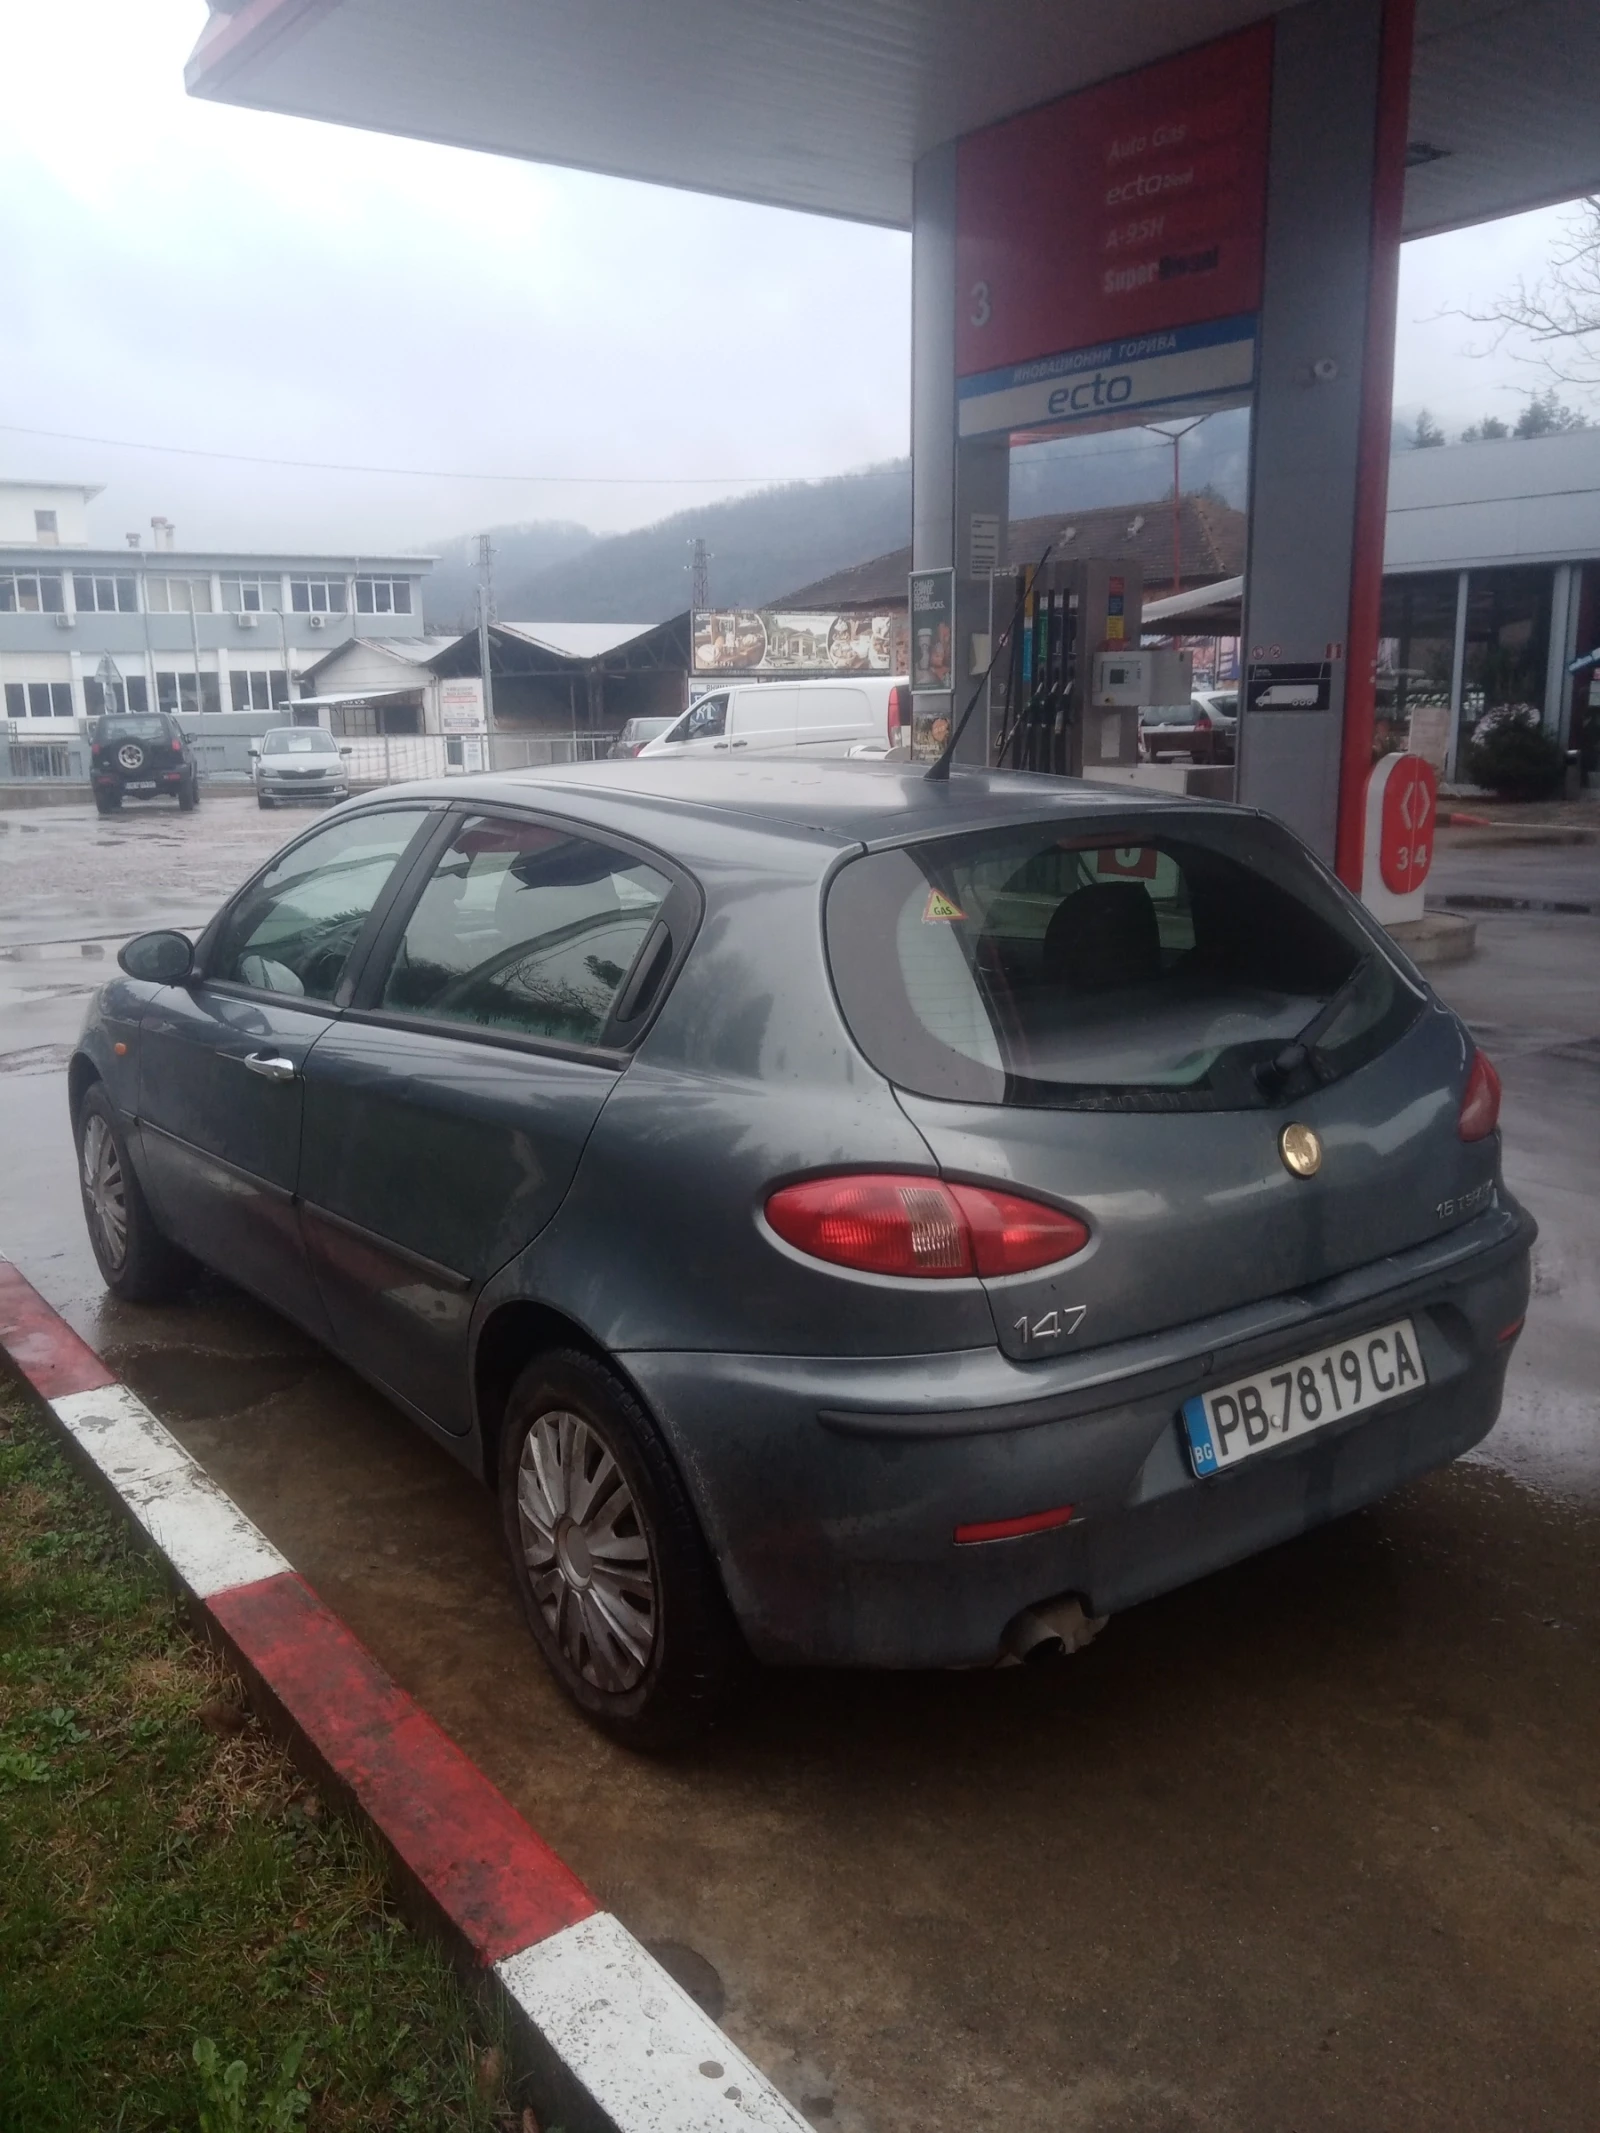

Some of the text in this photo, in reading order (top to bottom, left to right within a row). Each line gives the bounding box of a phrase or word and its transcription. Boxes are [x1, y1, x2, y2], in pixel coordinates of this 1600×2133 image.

[1107, 124, 1187, 165] Auto Gas
[970, 280, 991, 327] 3
[1013, 334, 1178, 383] ИНОВАЦИОННИ ГОРИВА
[1048, 372, 1133, 414] ecto
[1396, 844, 1428, 871] 3 4
[934, 906, 953, 916] GAS
[1013, 1304, 1087, 1344] 147
[1194, 1442, 1214, 1464] BG
